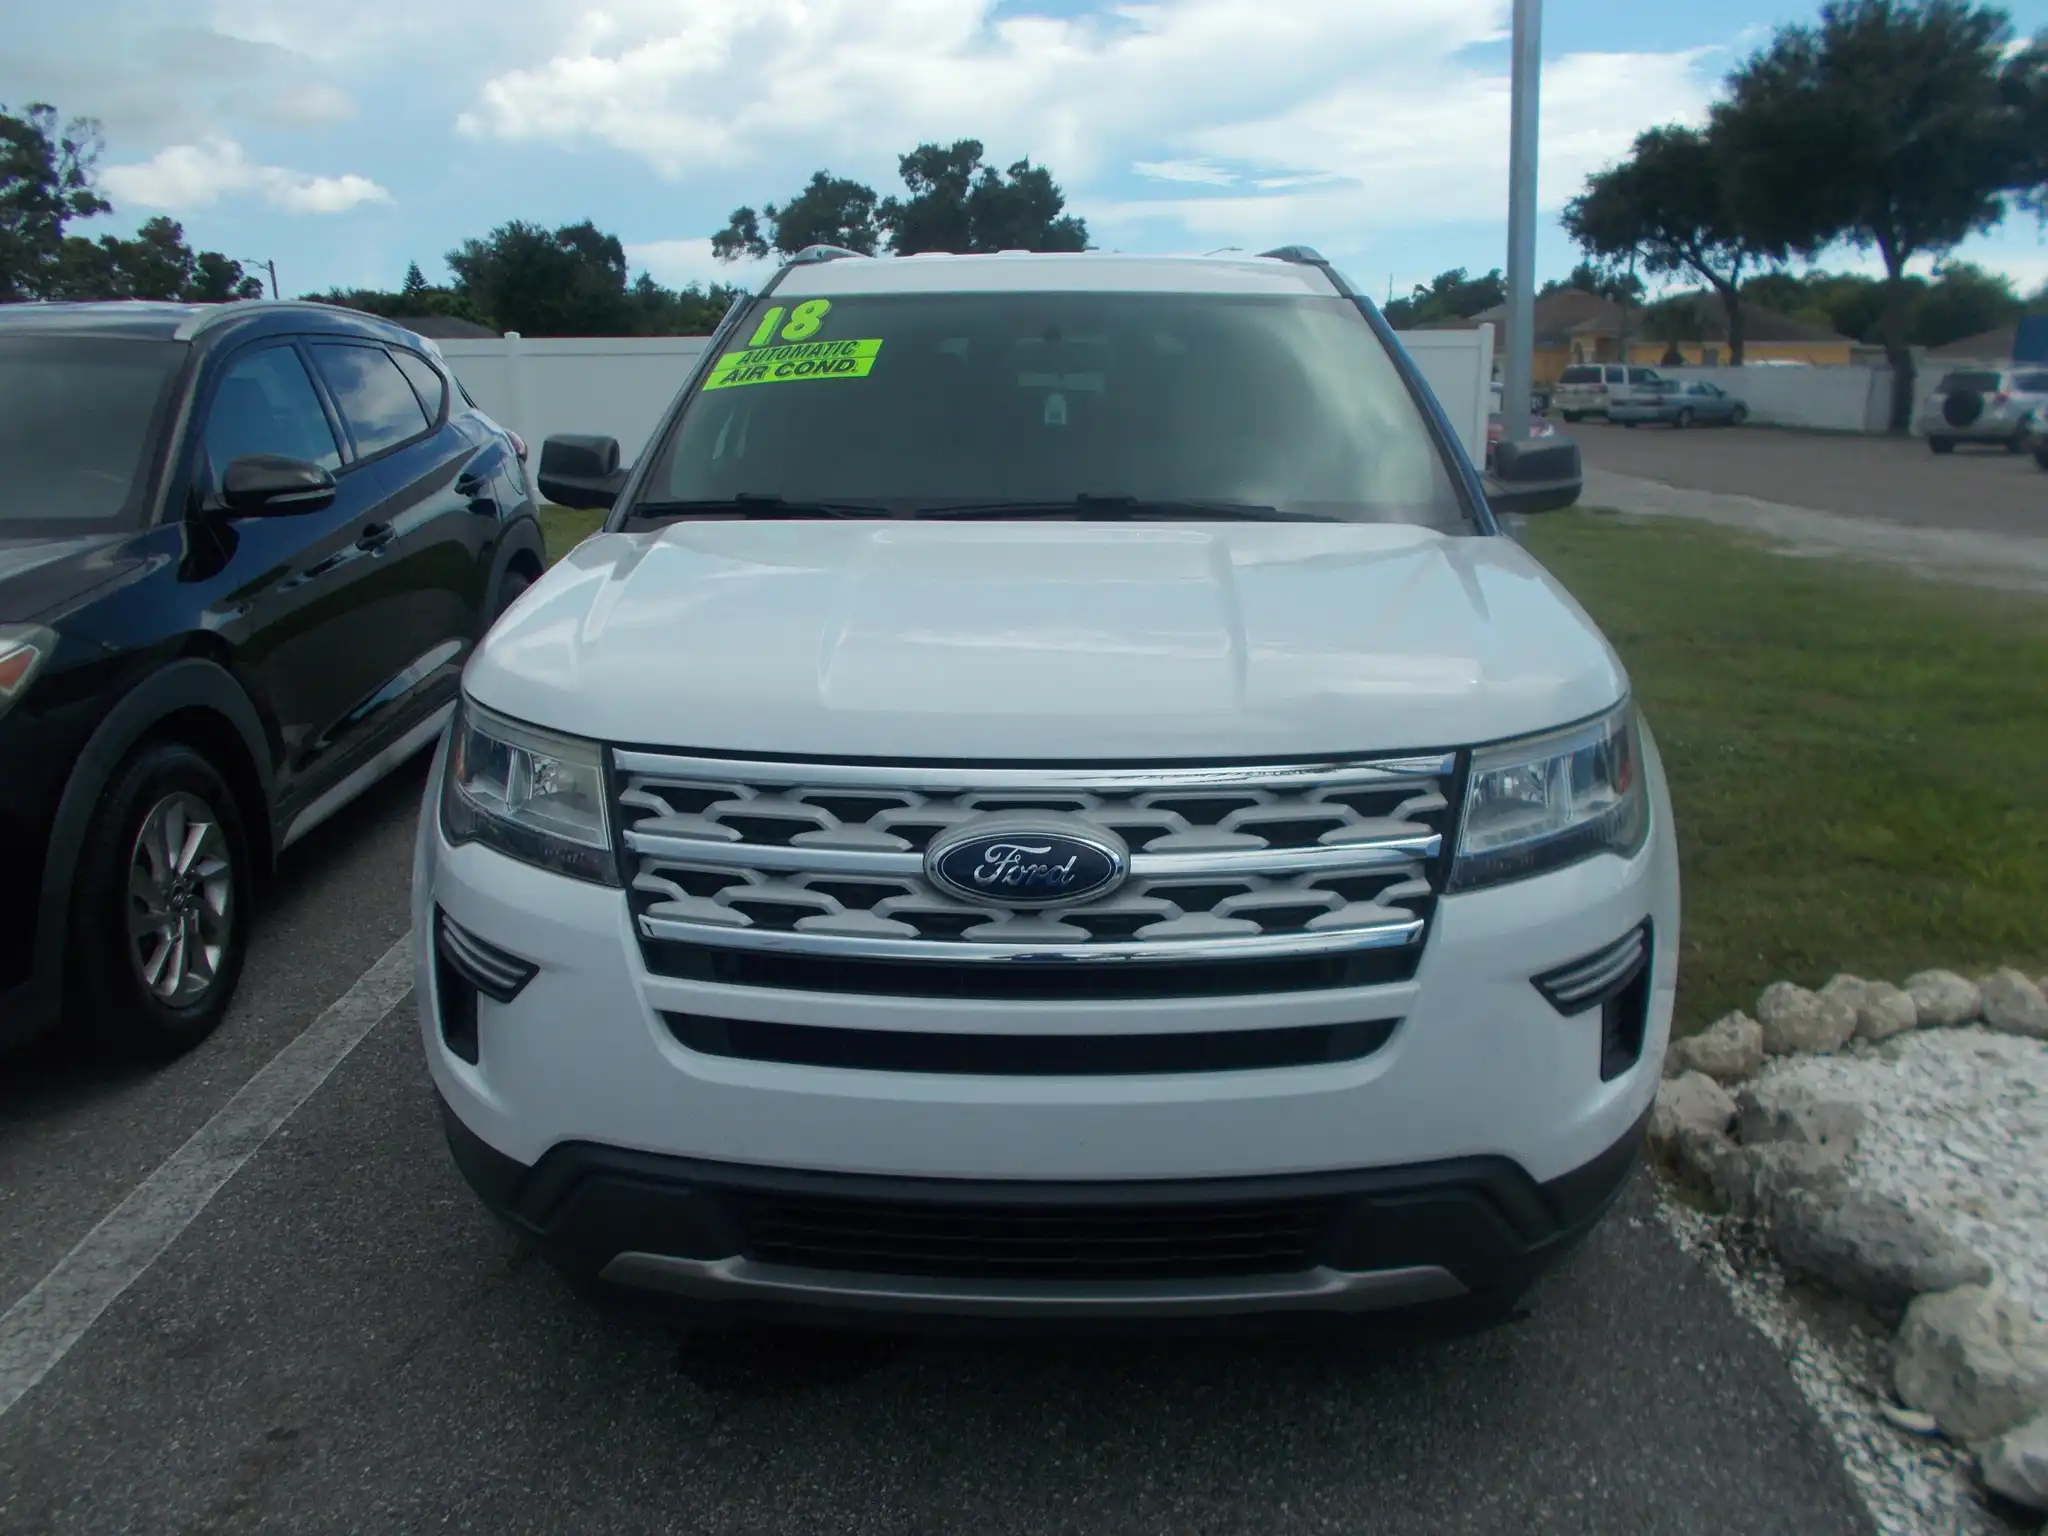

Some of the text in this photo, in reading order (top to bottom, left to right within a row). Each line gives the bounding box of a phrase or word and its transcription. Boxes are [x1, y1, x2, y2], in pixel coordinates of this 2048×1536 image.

[749, 299, 831, 346] 18
[736, 340, 860, 365] AUTOMATIC
[719, 358, 857, 384] AIR COND.
[974, 843, 1077, 886] Ford
